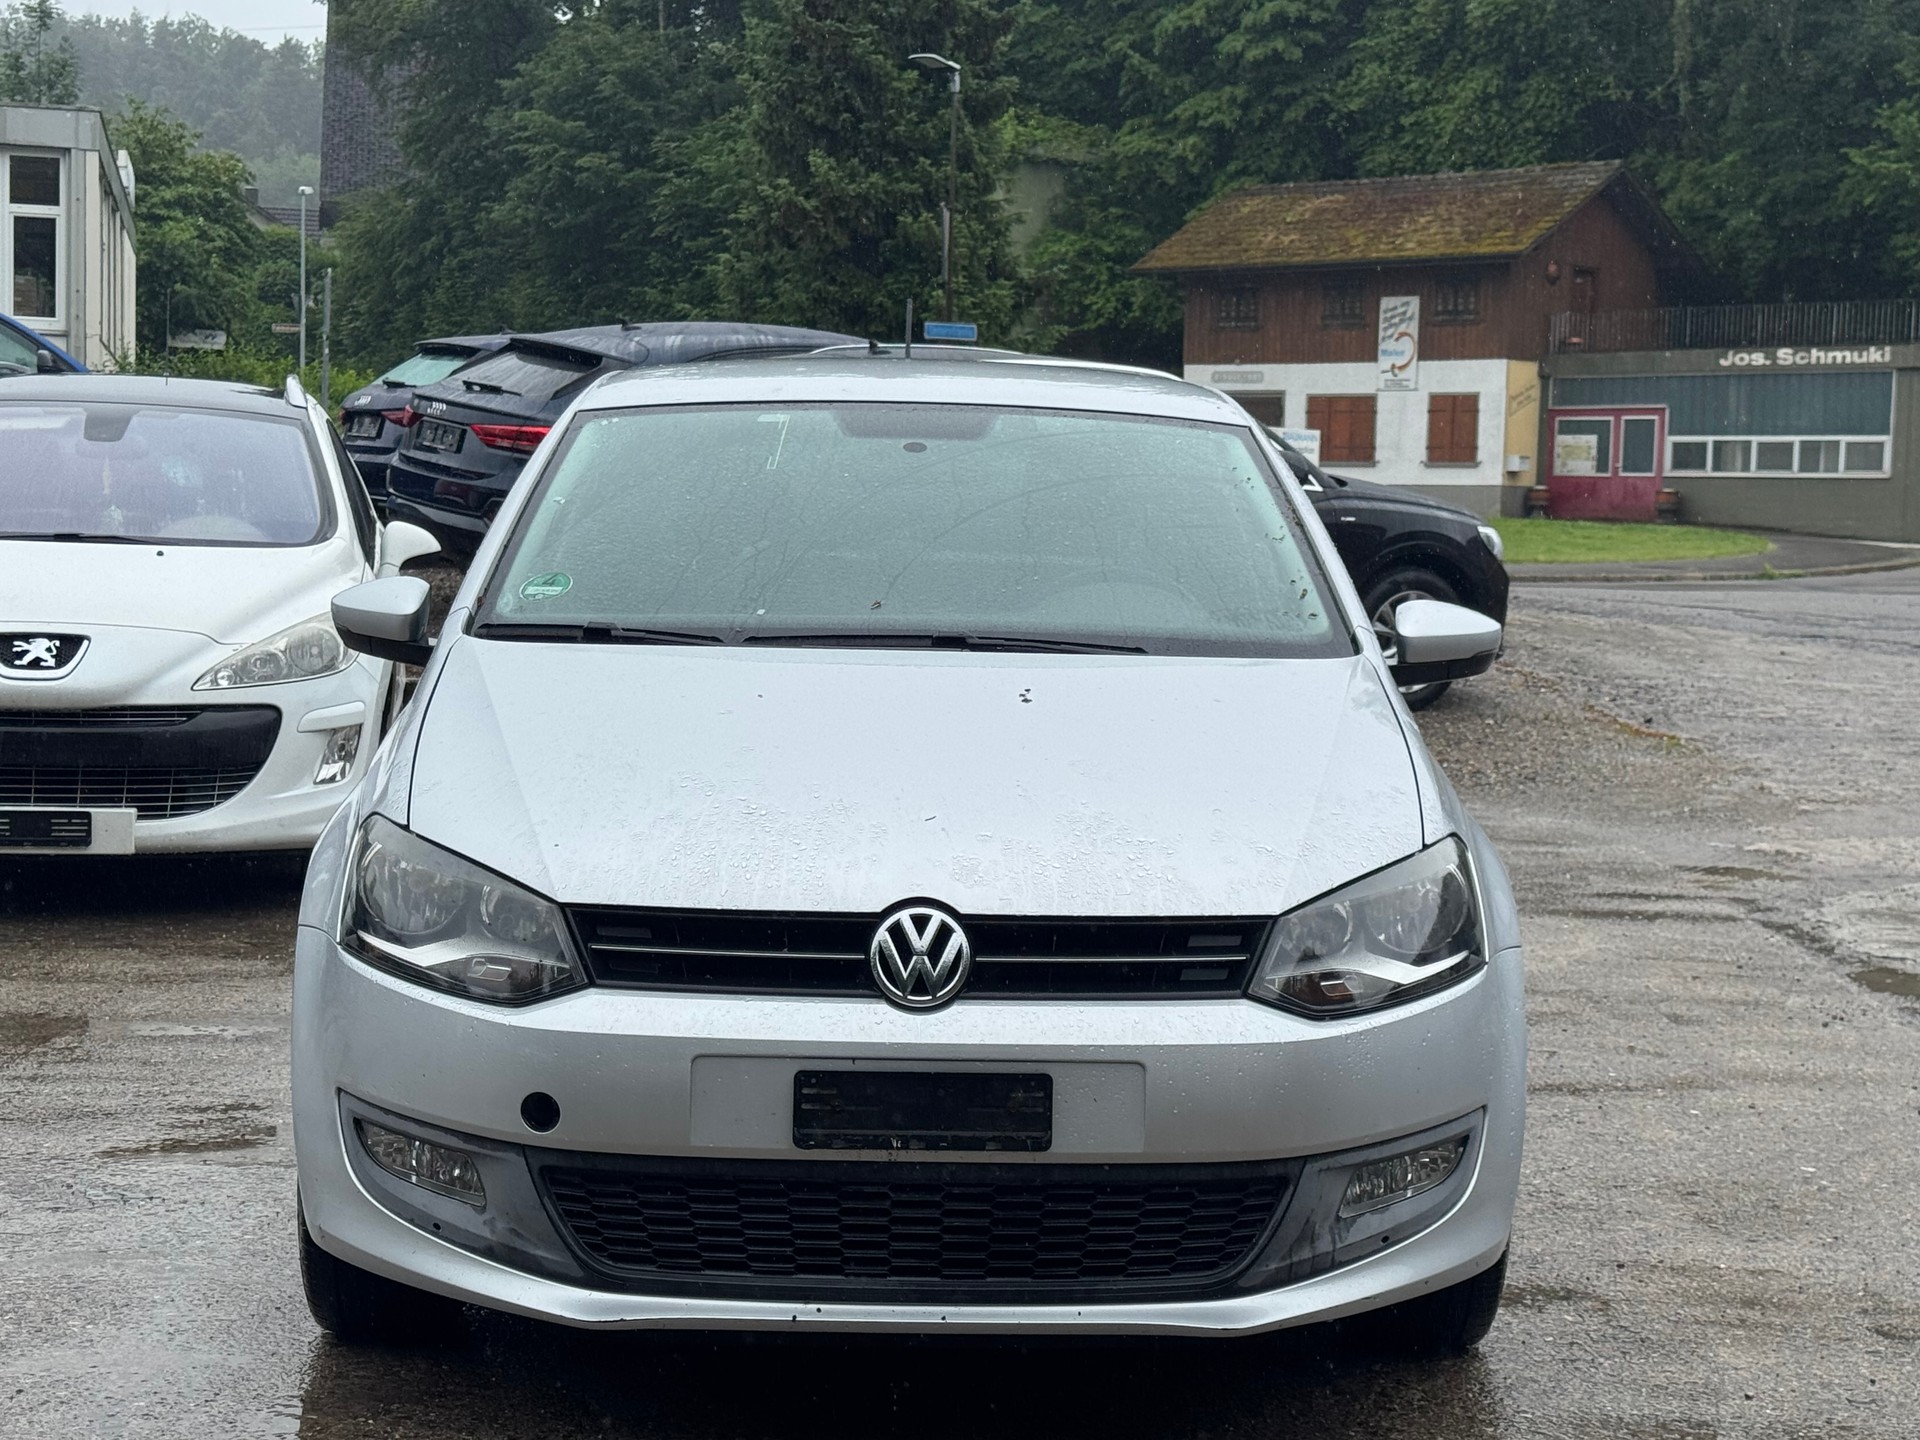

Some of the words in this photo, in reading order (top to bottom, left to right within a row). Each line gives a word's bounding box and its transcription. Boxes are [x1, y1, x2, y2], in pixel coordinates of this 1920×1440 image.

[1719, 351, 1772, 366] Jos.
[1776, 346, 1891, 365] Schmuki
[872, 908, 969, 1006] VW
